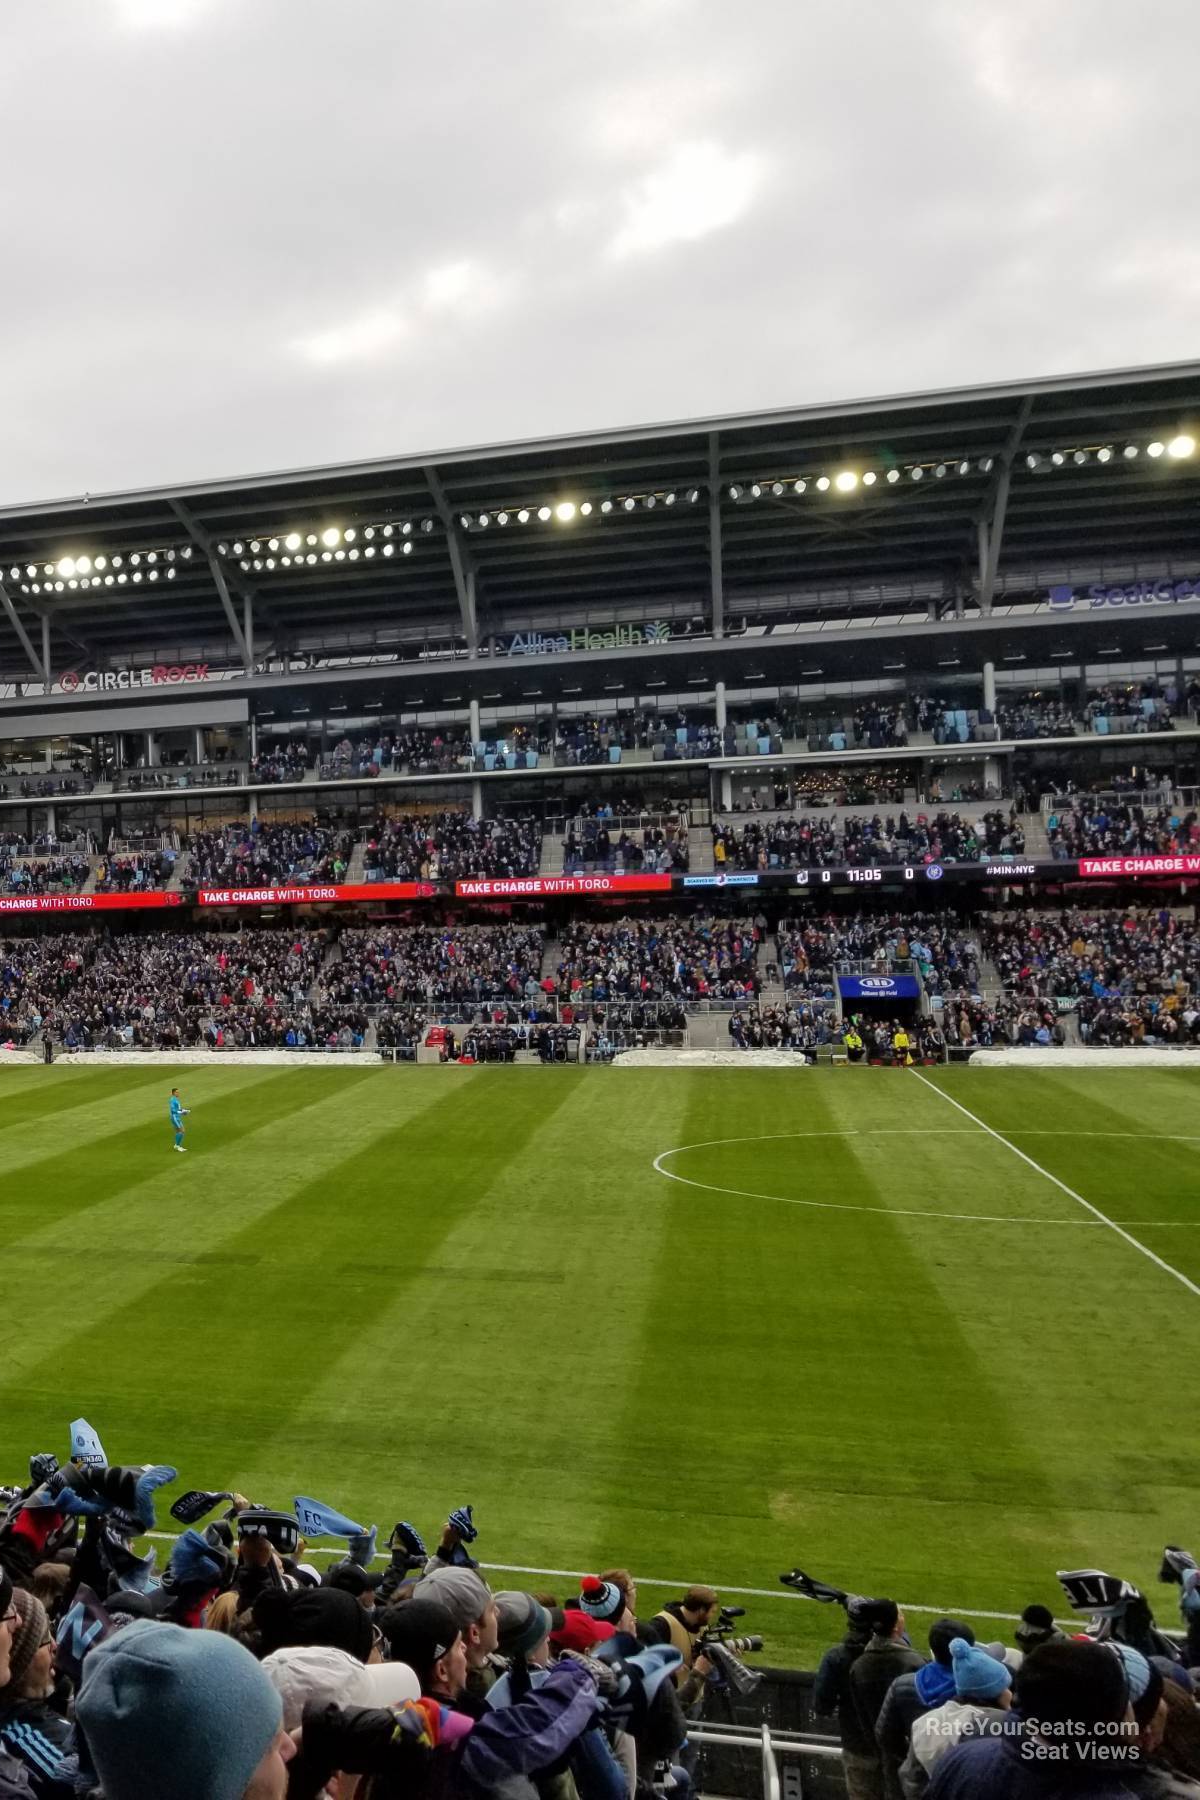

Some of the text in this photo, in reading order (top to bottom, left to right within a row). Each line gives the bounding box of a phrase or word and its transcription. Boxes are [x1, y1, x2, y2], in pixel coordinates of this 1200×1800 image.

[1084, 861, 1120, 873] TAKE
[1124, 860, 1183, 872] CHARGE
[822, 871, 831, 882] 0
[847, 869, 882, 882] 11:05
[905, 868, 914, 880] 0
[460, 878, 613, 894] TAKE CHARGE WITH TORO.
[203, 888, 339, 902] TAKE CHARGE WITH TORO.
[0, 899, 38, 910] CHARGE
[40, 898, 64, 908] WITH
[67, 897, 95, 907] TORO.
[304, 1510, 322, 1527] FC
